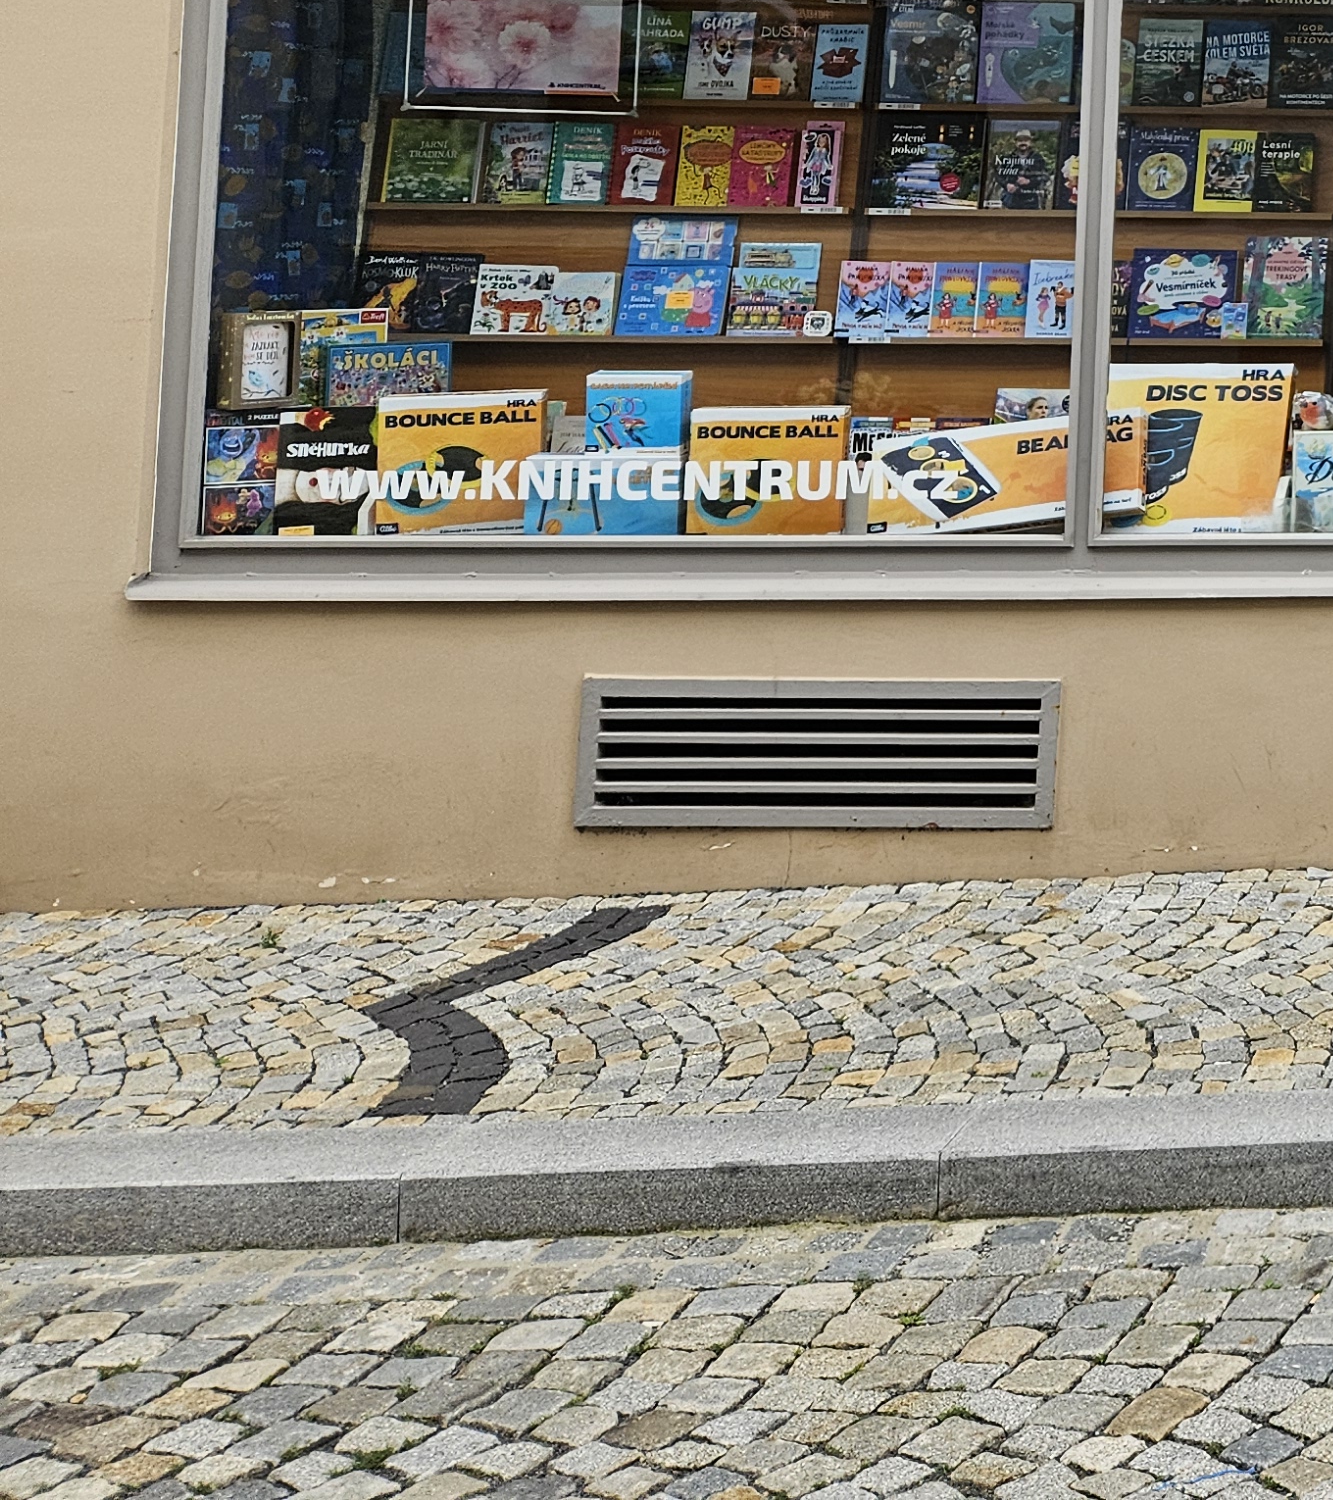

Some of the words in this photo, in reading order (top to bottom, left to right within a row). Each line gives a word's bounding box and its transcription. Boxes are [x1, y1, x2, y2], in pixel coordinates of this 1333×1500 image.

[702, 16, 742, 30] GUMP
[1298, 24, 1324, 32] IGOR
[760, 25, 811, 39] DUSTY
[1206, 36, 1219, 48] NA
[1223, 31, 1270, 46] MOTORCE
[891, 132, 927, 143] Zelené
[890, 145, 927, 156] pokoje
[1262, 140, 1292, 149] Lesní
[1262, 150, 1301, 160] terapie
[480, 274, 514, 283] Krtek
[742, 274, 801, 291] VLÁČKY
[1275, 273, 1298, 281] TRASY
[490, 282, 518, 290] ZOO
[1155, 278, 1218, 293] Vesmírníček
[342, 348, 439, 370] ŠKOLÁCI
[1242, 369, 1286, 381] HRA
[1145, 384, 1208, 402] DISC
[1215, 385, 1284, 402] TOSS
[506, 399, 538, 408] HRA
[384, 411, 475, 429] BOUNCE
[480, 409, 538, 425] BALL
[811, 414, 840, 423] HRA
[696, 426, 781, 440] BOUNCE
[785, 424, 839, 438] BALL
[315, 459, 960, 501] www.KNIHCENTRUM.cz
